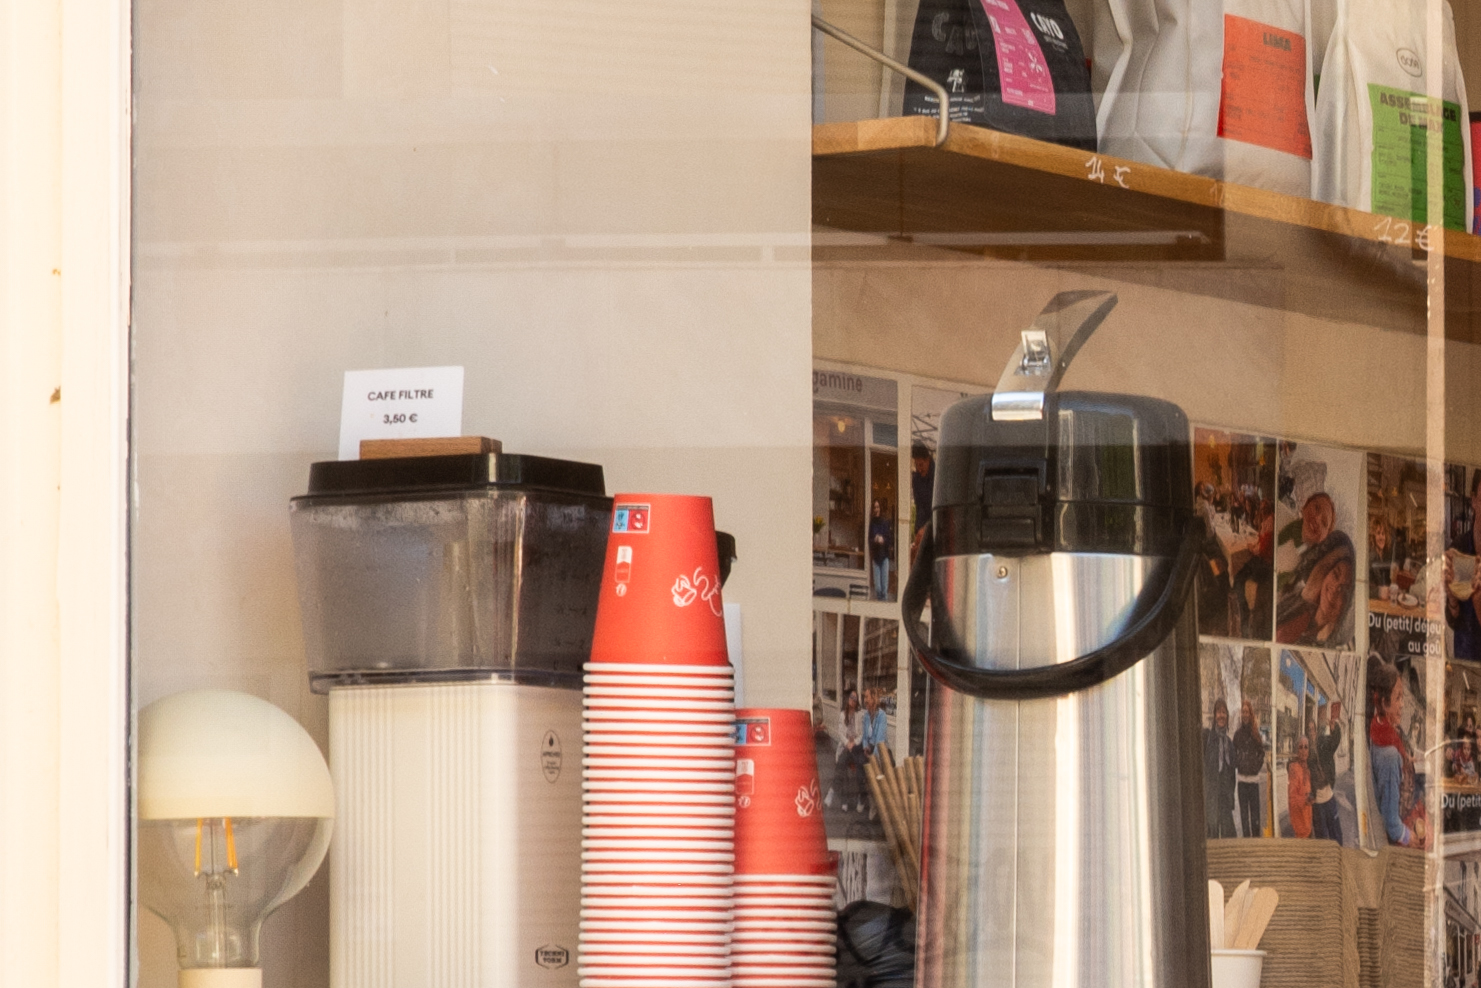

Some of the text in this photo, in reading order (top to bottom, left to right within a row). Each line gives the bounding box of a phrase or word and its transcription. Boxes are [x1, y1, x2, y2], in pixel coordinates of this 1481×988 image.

[368, 389, 434, 401] CAFE FILTRE
[383, 413, 418, 425] 3,50 €
[1369, 612, 1381, 628] Du
[1384, 612, 1413, 634] (petit)
[1408, 641, 1421, 652] au
